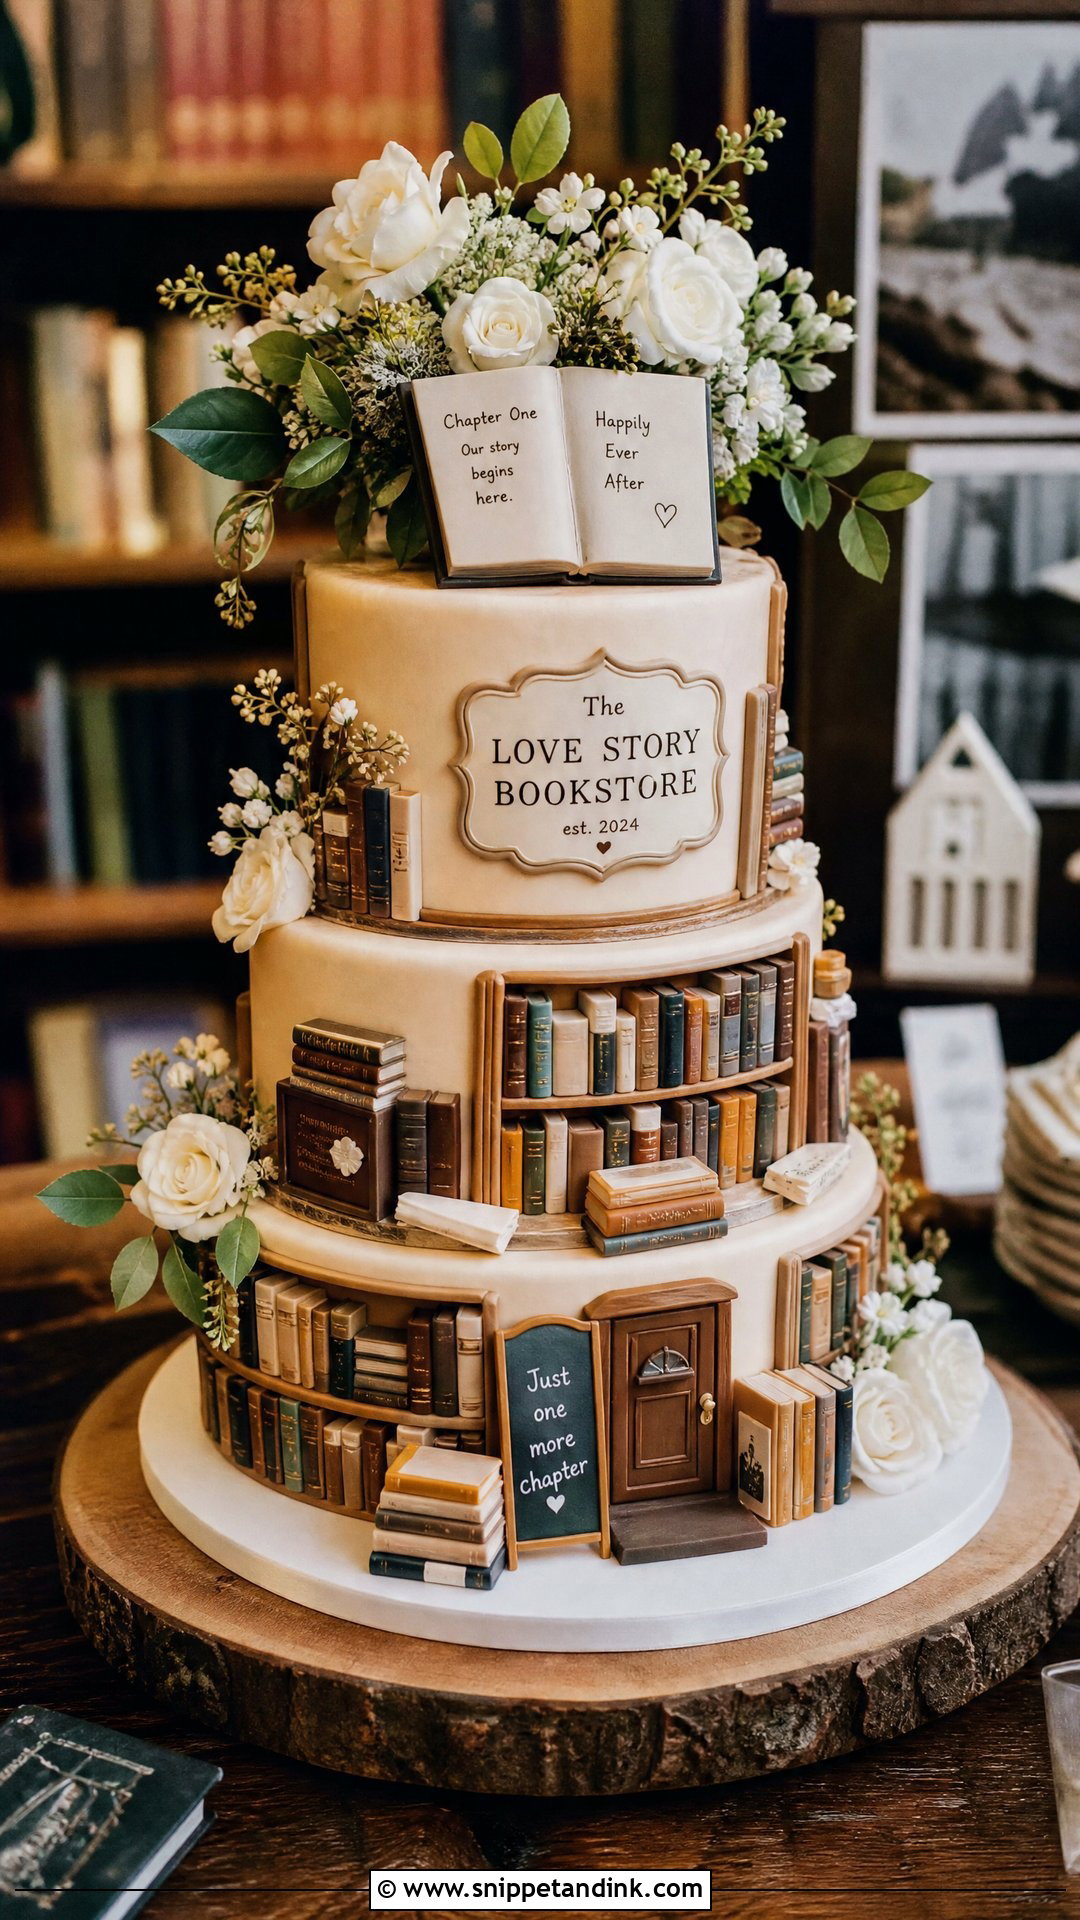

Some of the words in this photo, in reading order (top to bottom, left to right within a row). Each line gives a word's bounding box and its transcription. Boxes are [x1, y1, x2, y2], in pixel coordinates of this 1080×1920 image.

[443, 409, 502, 431] Chapter
[509, 407, 538, 421] One
[595, 410, 651, 437] Happily
[461, 443, 483, 457] Our
[490, 440, 520, 455] story
[605, 443, 639, 460] Ever
[471, 466, 514, 484] begins
[604, 473, 645, 493] After
[476, 491, 513, 505] here.
[583, 695, 625, 717] The
[492, 738, 582, 764] LOVE
[603, 728, 700, 762] STORY
[494, 769, 697, 806] BOOKSTORE
[563, 821, 592, 836] est.
[599, 818, 640, 834] 2024
[527, 1366, 571, 1392] Just
[533, 1404, 567, 1422] one
[529, 1433, 576, 1458] more
[520, 1460, 588, 1495] chapter
